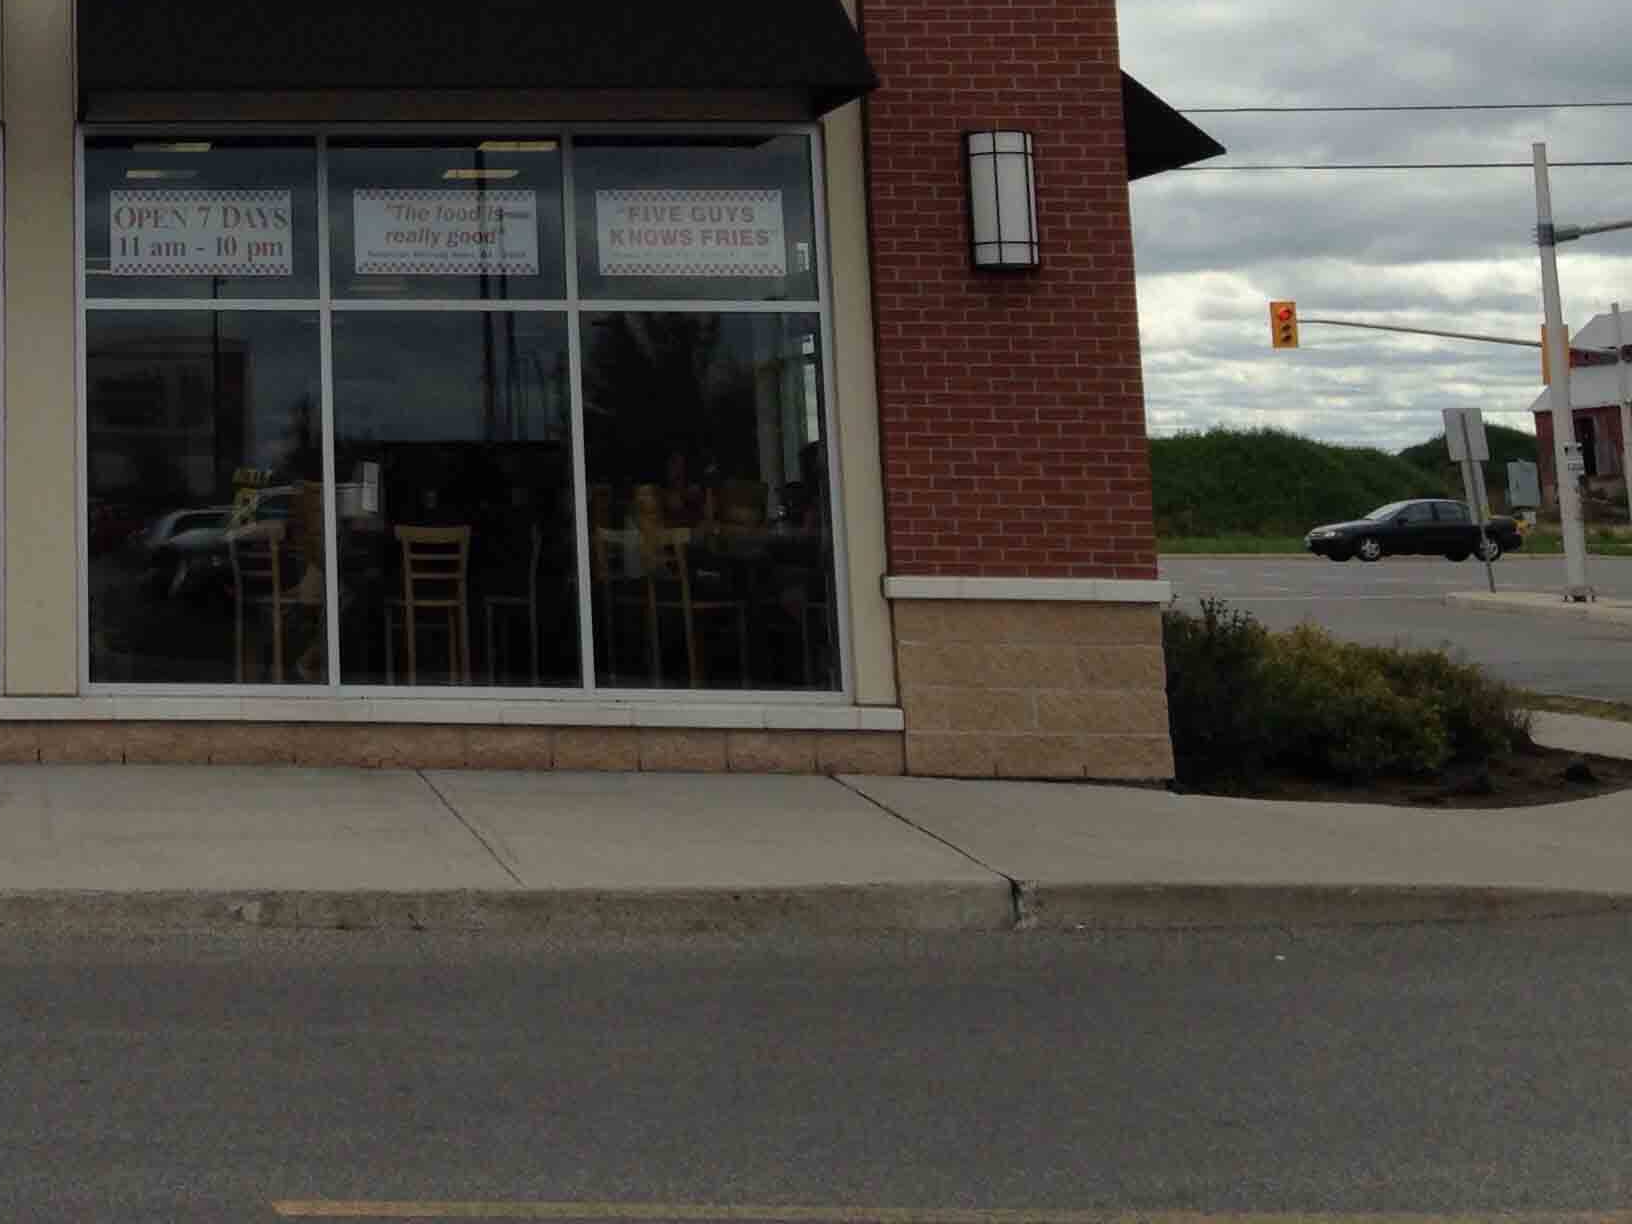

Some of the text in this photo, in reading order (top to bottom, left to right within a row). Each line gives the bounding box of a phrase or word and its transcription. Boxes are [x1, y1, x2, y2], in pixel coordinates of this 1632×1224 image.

[114, 205, 290, 230] OPEN 7 DAYS
[435, 204, 481, 222] food
[691, 206, 755, 223] GUYS
[384, 228, 441, 249] really
[609, 228, 691, 247] KNOWS
[119, 235, 139, 257] 11
[149, 240, 187, 257] am
[216, 235, 237, 257] 10
[247, 240, 284, 263] pm
